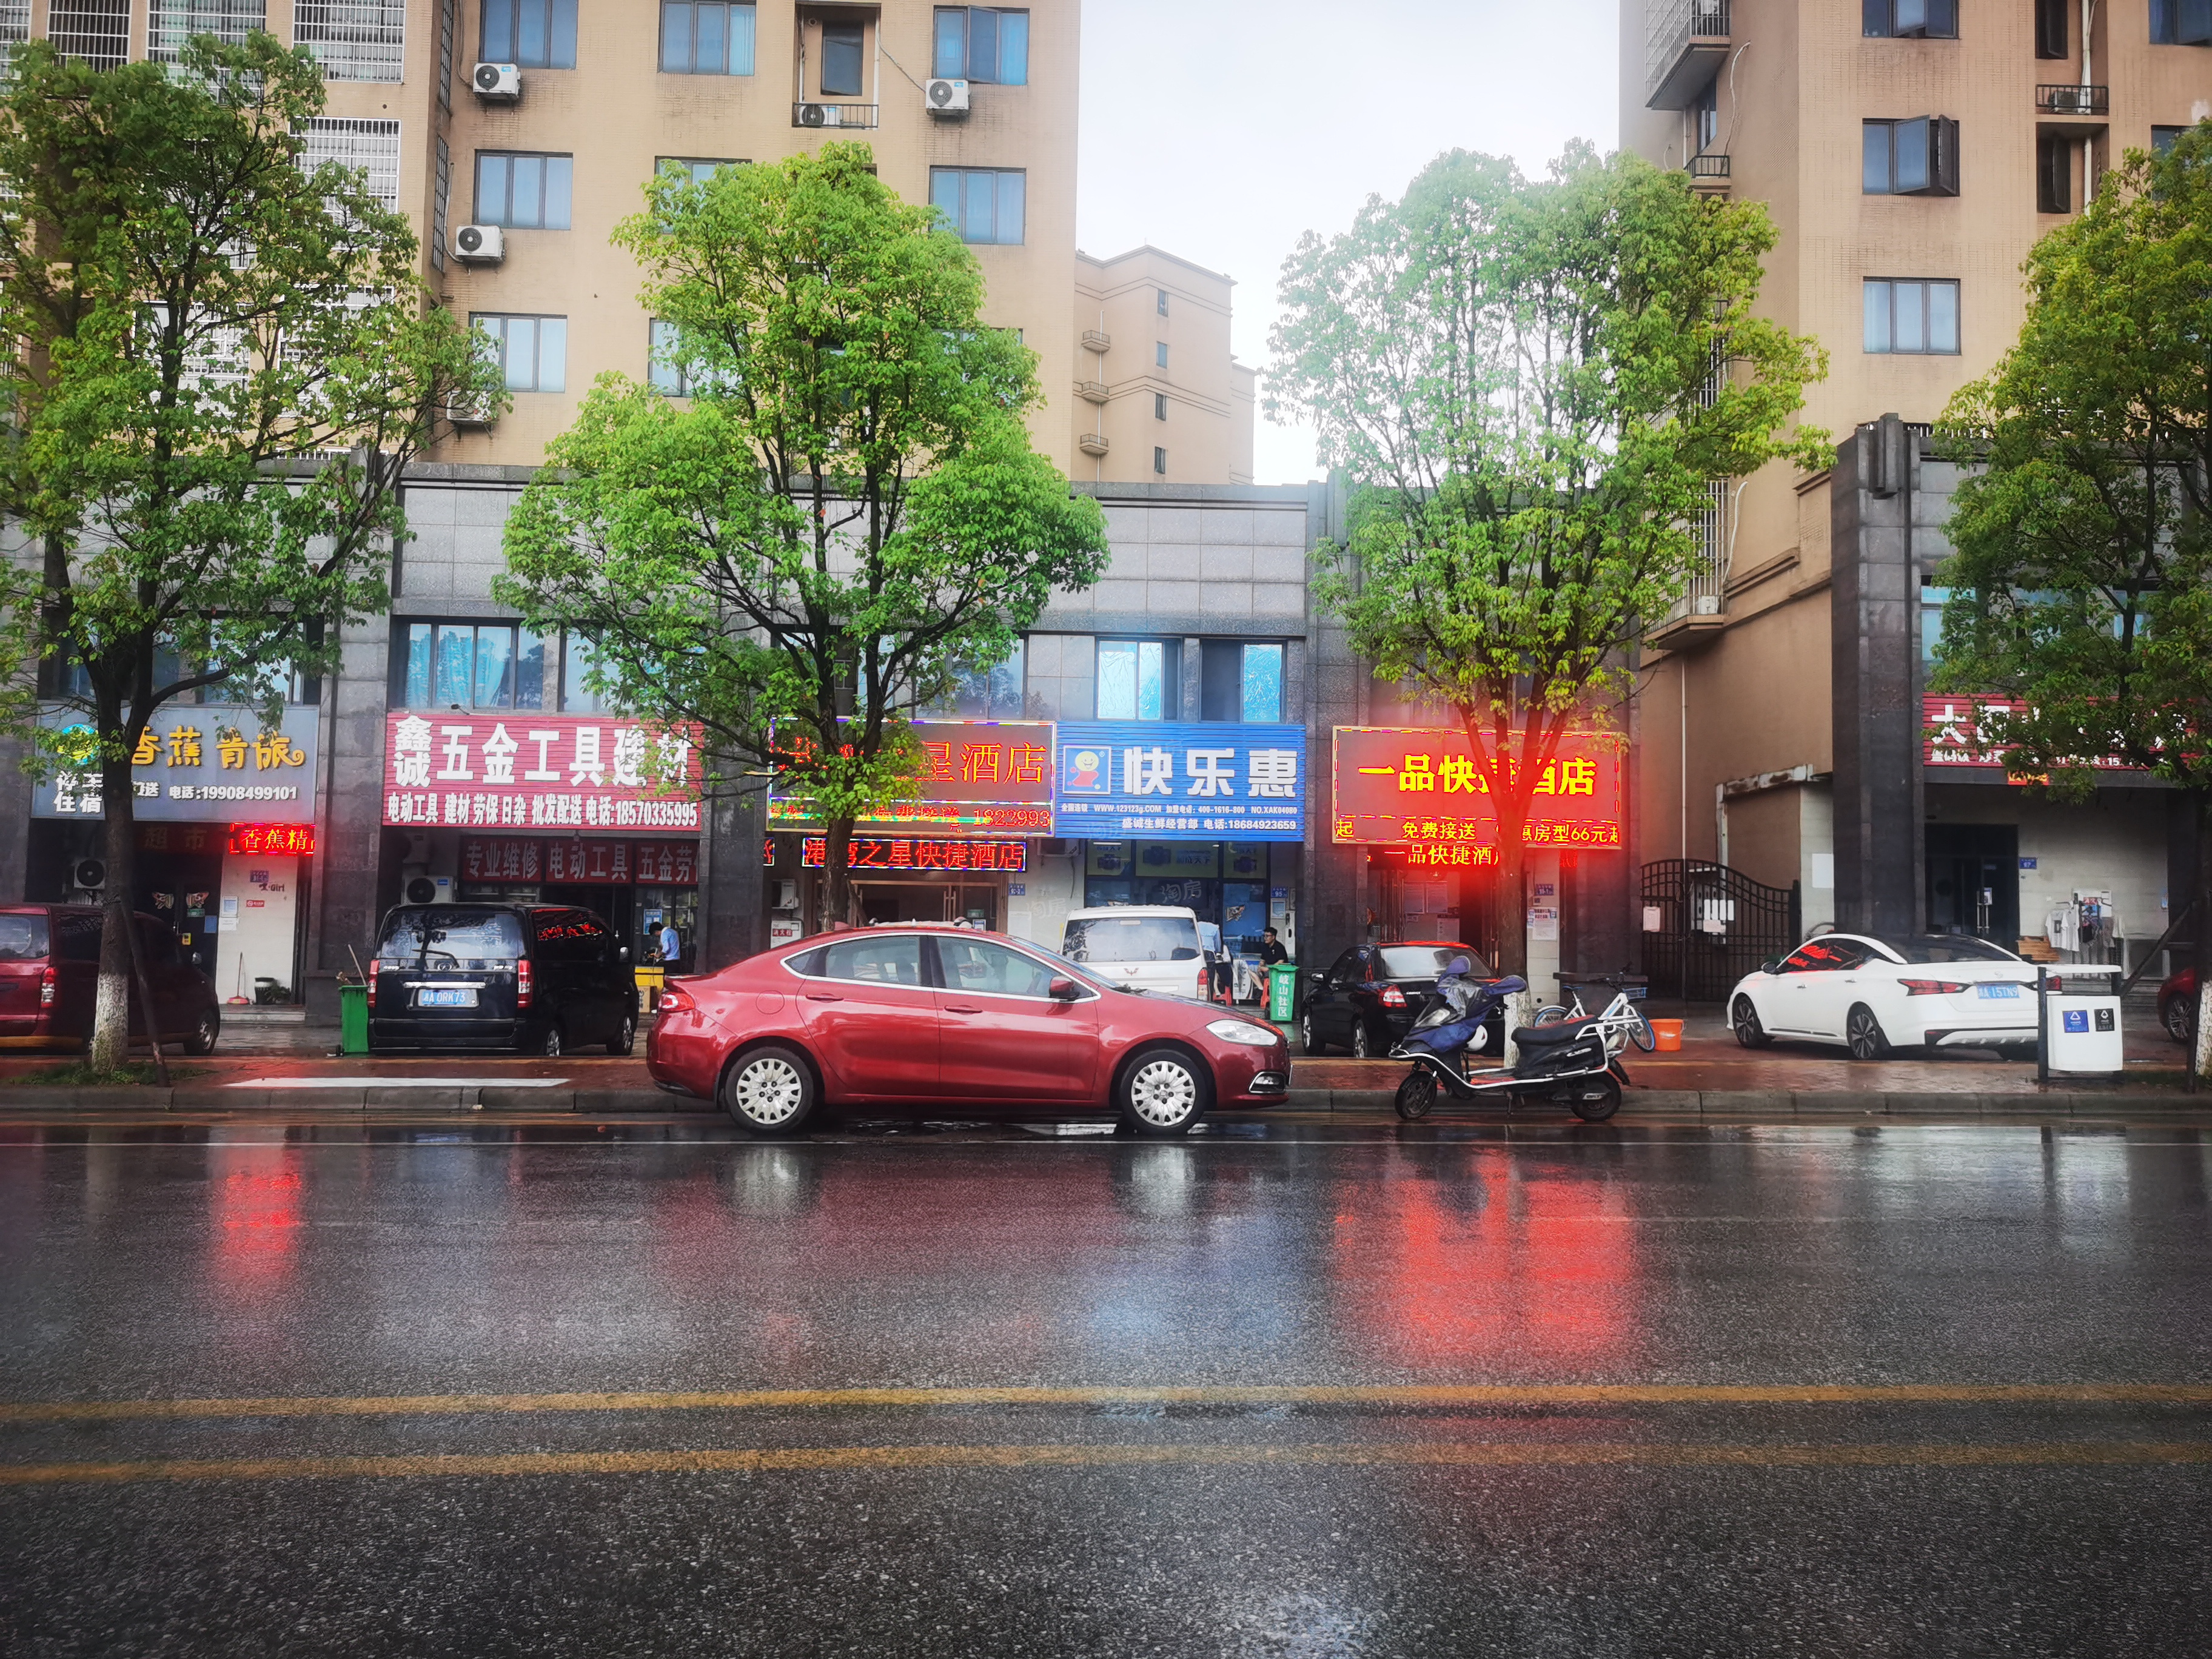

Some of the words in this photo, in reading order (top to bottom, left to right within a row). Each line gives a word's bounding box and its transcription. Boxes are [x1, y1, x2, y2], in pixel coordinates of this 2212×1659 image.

[1124, 746, 1298, 798] 快乐惠
[169, 786, 297, 800] 电话:19908499101
[388, 791, 438, 823] 电动工具
[444, 793, 471, 824] 建材
[473, 793, 498, 825] 劳保
[502, 793, 526, 825] 日杂
[532, 793, 582, 825] 批发配送
[586, 795, 698, 826] 电话:18570335995
[1122, 817, 1198, 830] 盛诚生鲜经营部
[1204, 819, 1296, 830] 电话:18684923659
[1401, 821, 1476, 840] 免费接送
[1496, 823, 1619, 843] 惠房型66元
[241, 828, 309, 850] 香蕉精
[466, 842, 539, 880] 专业维修
[549, 842, 629, 880] 电动工具
[638, 845, 698, 882] 五金劳
[1384, 844, 1499, 865] 一品快捷酒
